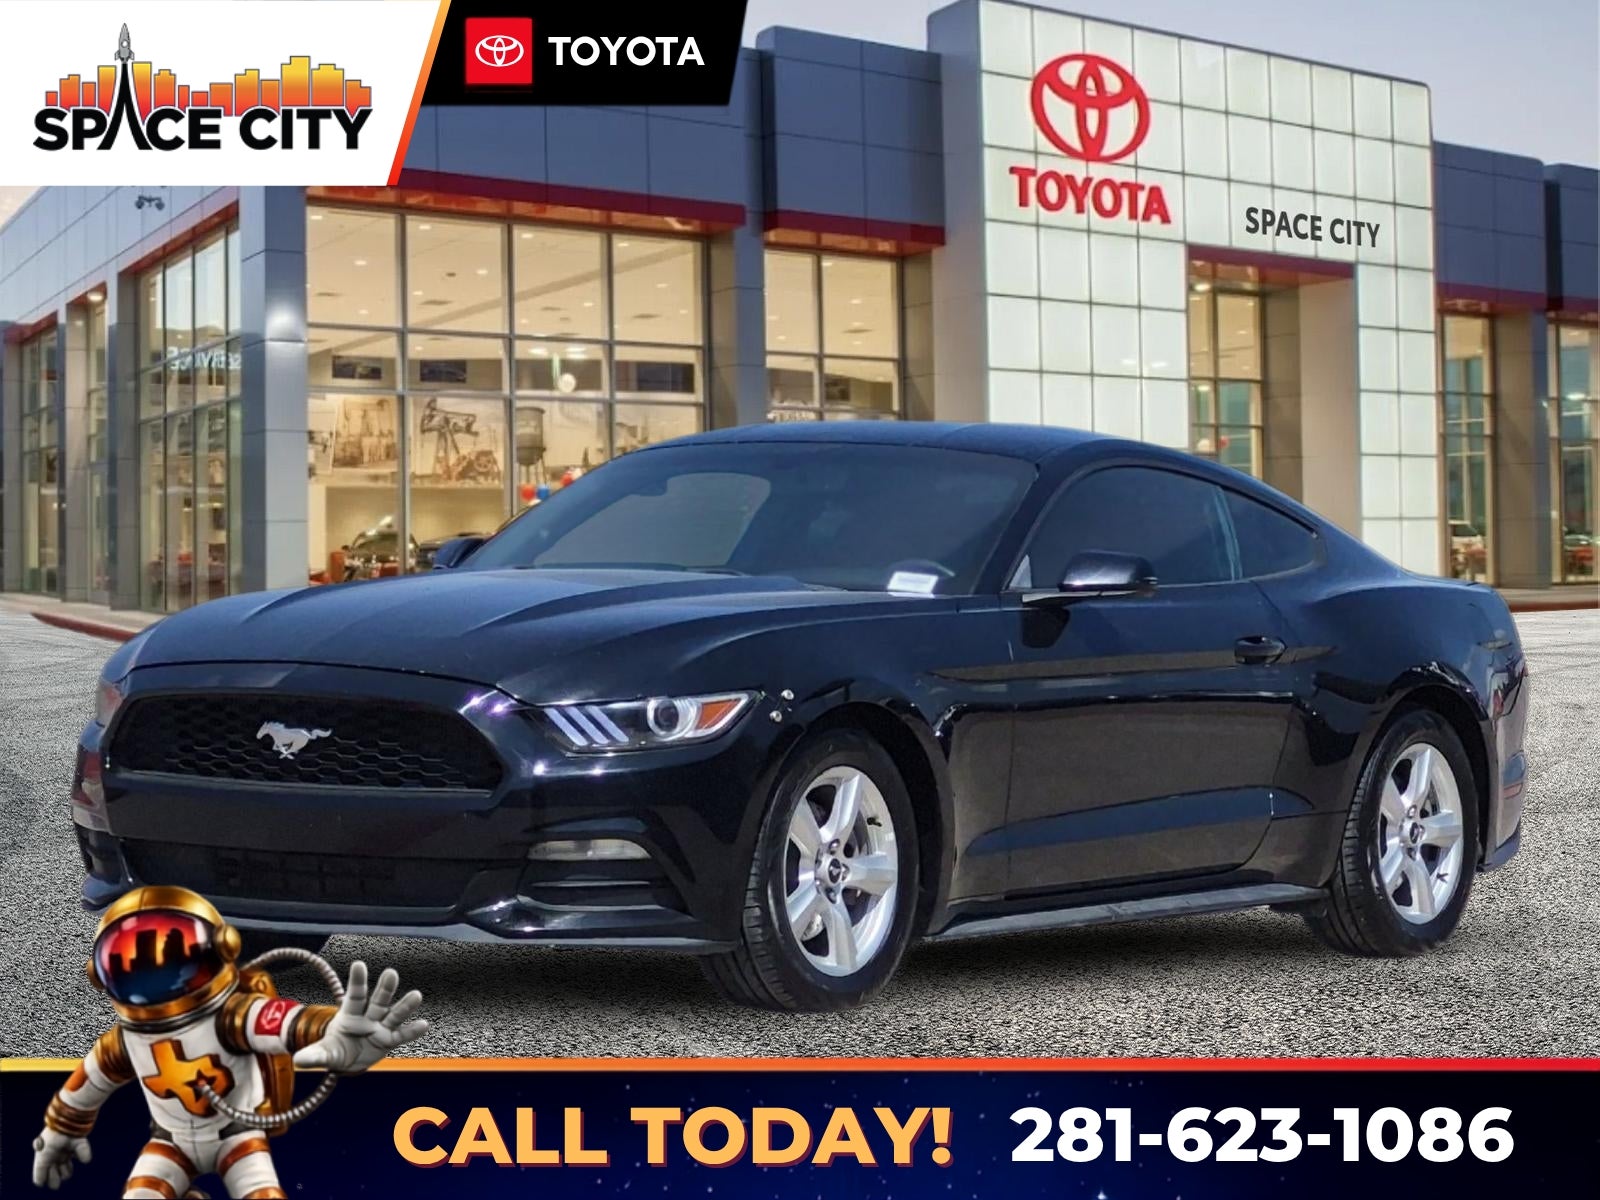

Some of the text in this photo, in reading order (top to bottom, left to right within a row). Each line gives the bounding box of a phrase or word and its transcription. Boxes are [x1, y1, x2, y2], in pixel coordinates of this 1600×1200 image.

[1009, 166, 1171, 224] TOYOTA
[1245, 206, 1380, 248] SPACE CITY
